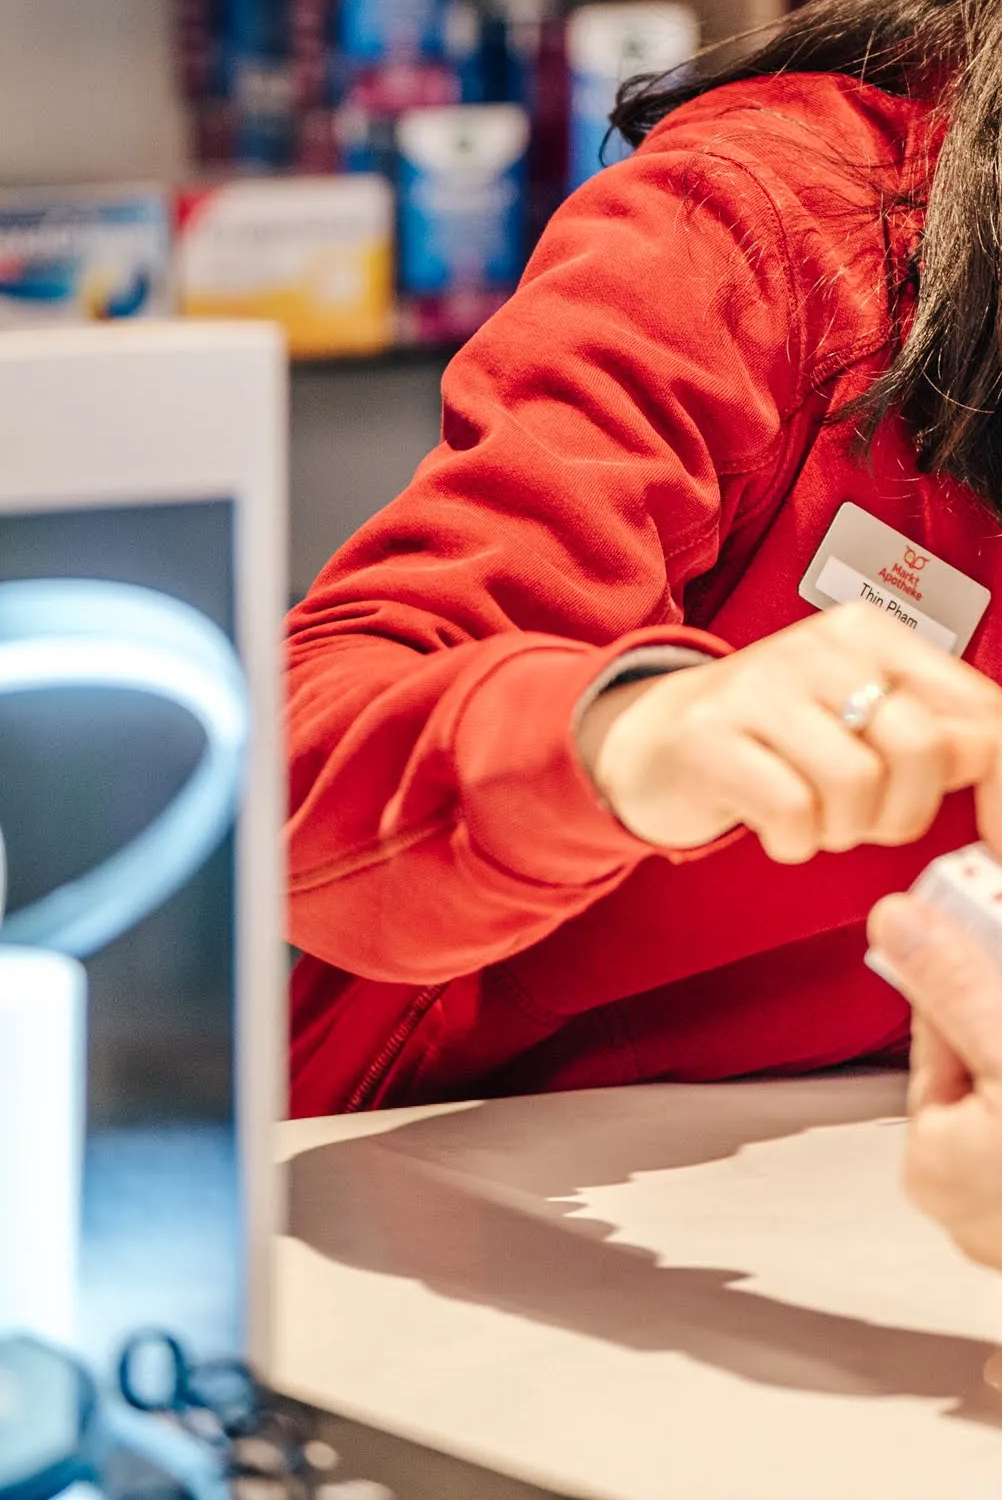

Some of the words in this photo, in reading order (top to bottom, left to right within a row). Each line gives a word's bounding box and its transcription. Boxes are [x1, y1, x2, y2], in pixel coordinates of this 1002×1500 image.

[878, 567, 924, 601] Apotheke
[891, 563, 920, 586] Markt
[860, 581, 884, 607] Thin
[885, 599, 918, 629] Pham
